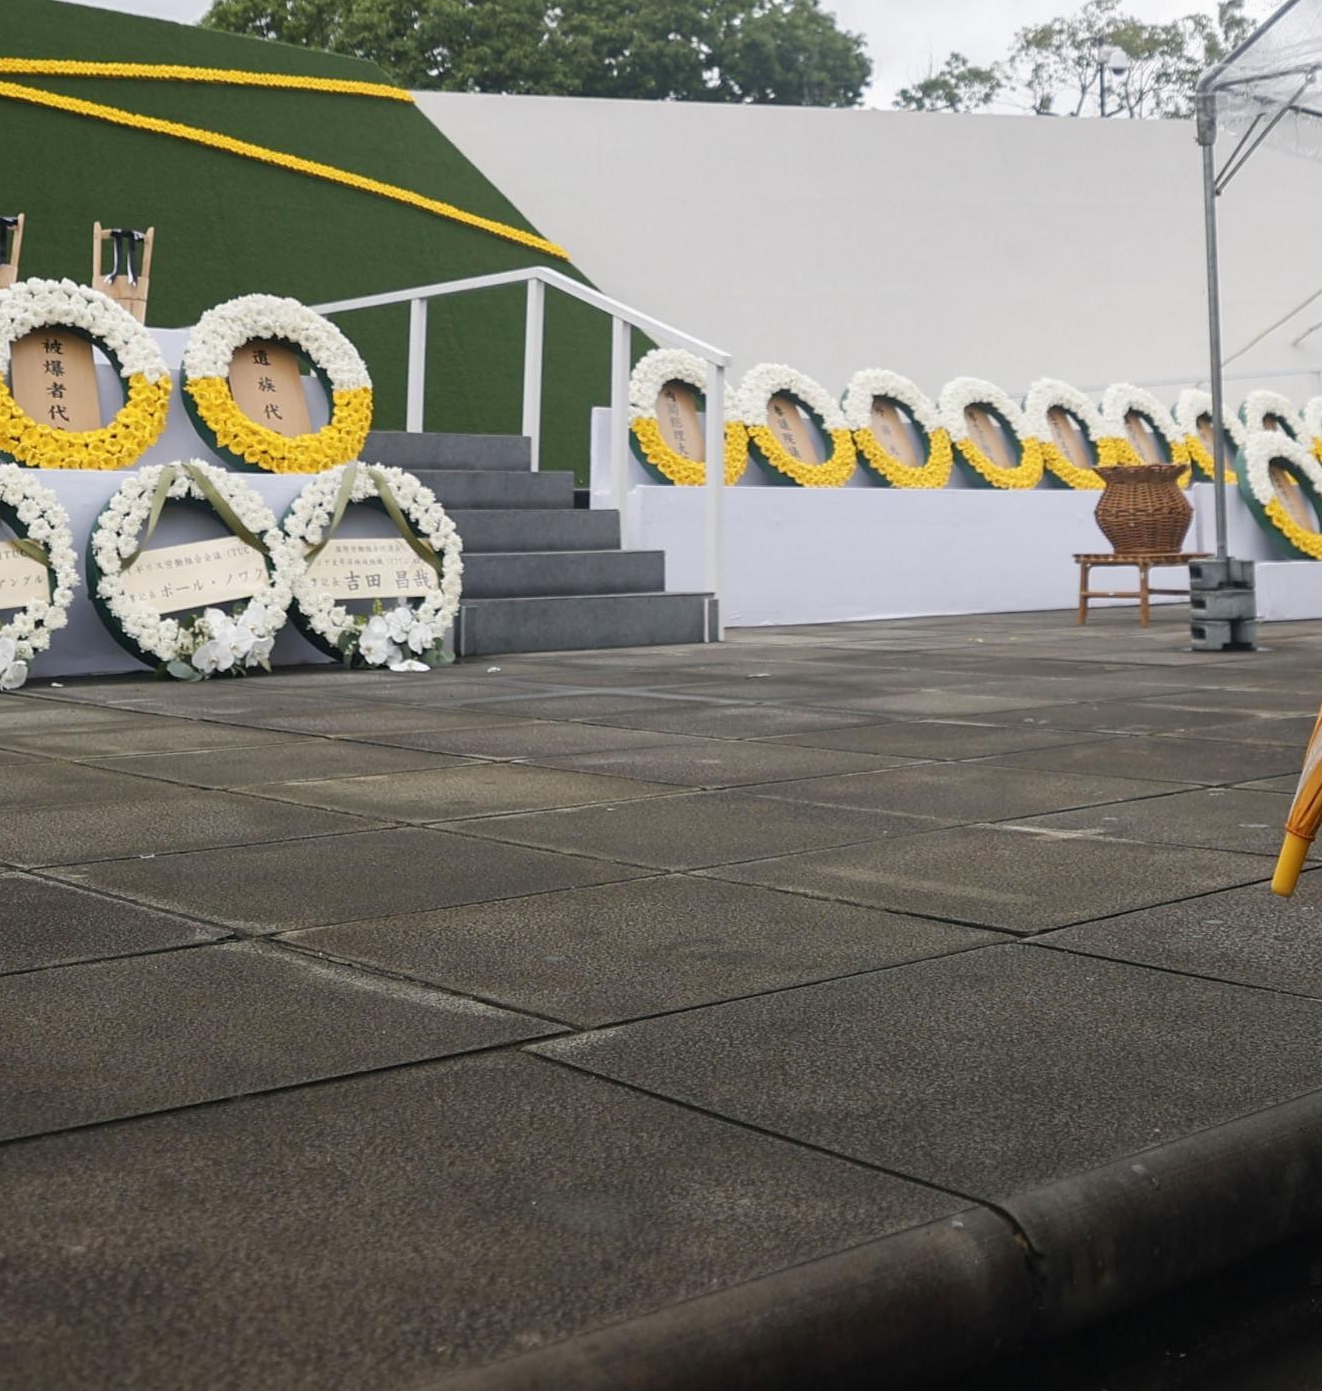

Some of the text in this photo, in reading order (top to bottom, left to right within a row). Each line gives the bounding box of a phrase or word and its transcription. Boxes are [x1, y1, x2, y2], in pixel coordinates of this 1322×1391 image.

[41, 338, 70, 431] 被爆者代
[252, 350, 283, 434] 遺族代
[345, 570, 382, 592] 吉田
